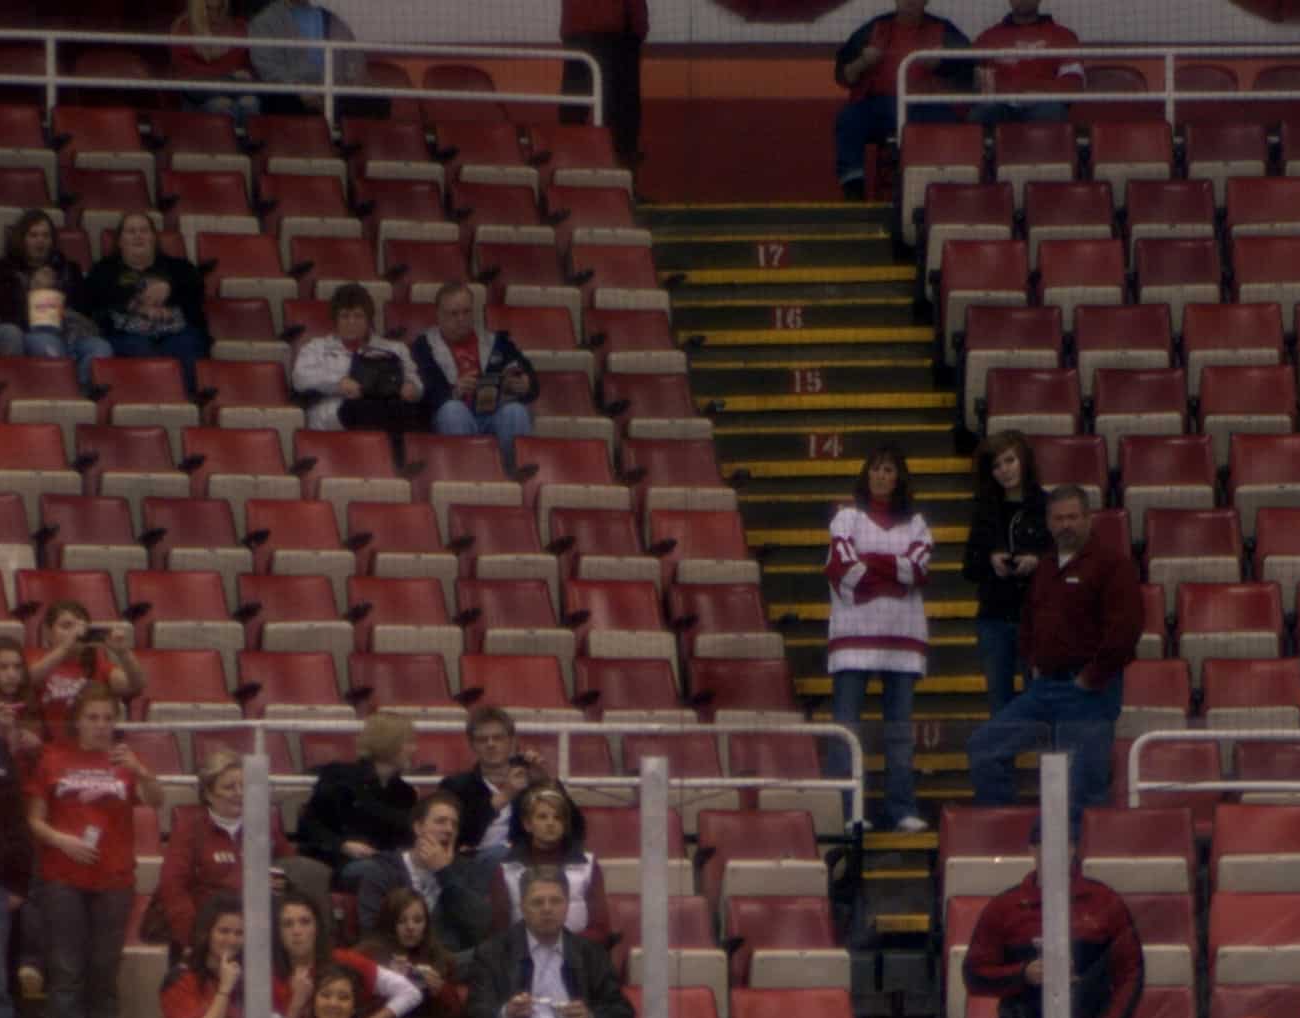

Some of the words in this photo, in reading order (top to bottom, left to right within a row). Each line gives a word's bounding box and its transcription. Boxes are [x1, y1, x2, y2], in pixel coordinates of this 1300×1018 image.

[758, 245, 784, 267] 17
[775, 307, 804, 329] 16
[795, 370, 823, 393] 15
[809, 434, 842, 457] 14
